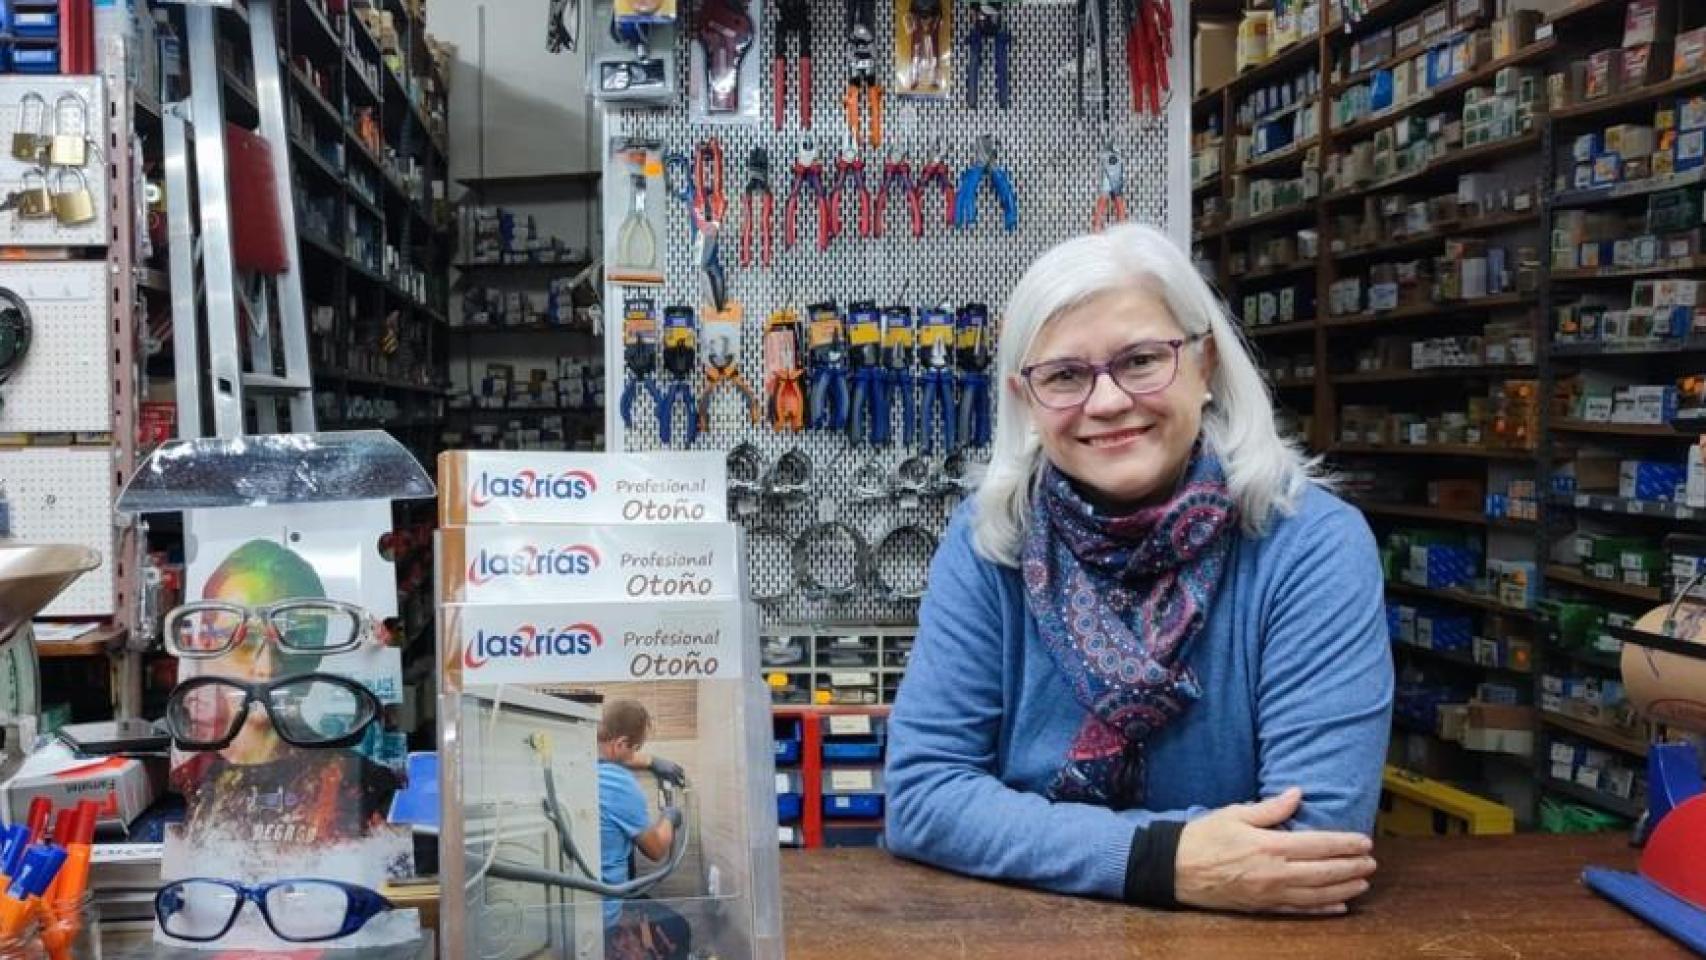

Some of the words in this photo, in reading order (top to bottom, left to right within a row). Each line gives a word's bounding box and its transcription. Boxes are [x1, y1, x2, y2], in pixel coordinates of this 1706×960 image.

[616, 478, 706, 494] Profesional
[622, 498, 705, 521] Otoño
[620, 551, 713, 568] Profesional
[626, 572, 712, 596] Otoño
[624, 629, 720, 647] Profesional
[630, 650, 719, 677] Otoño
